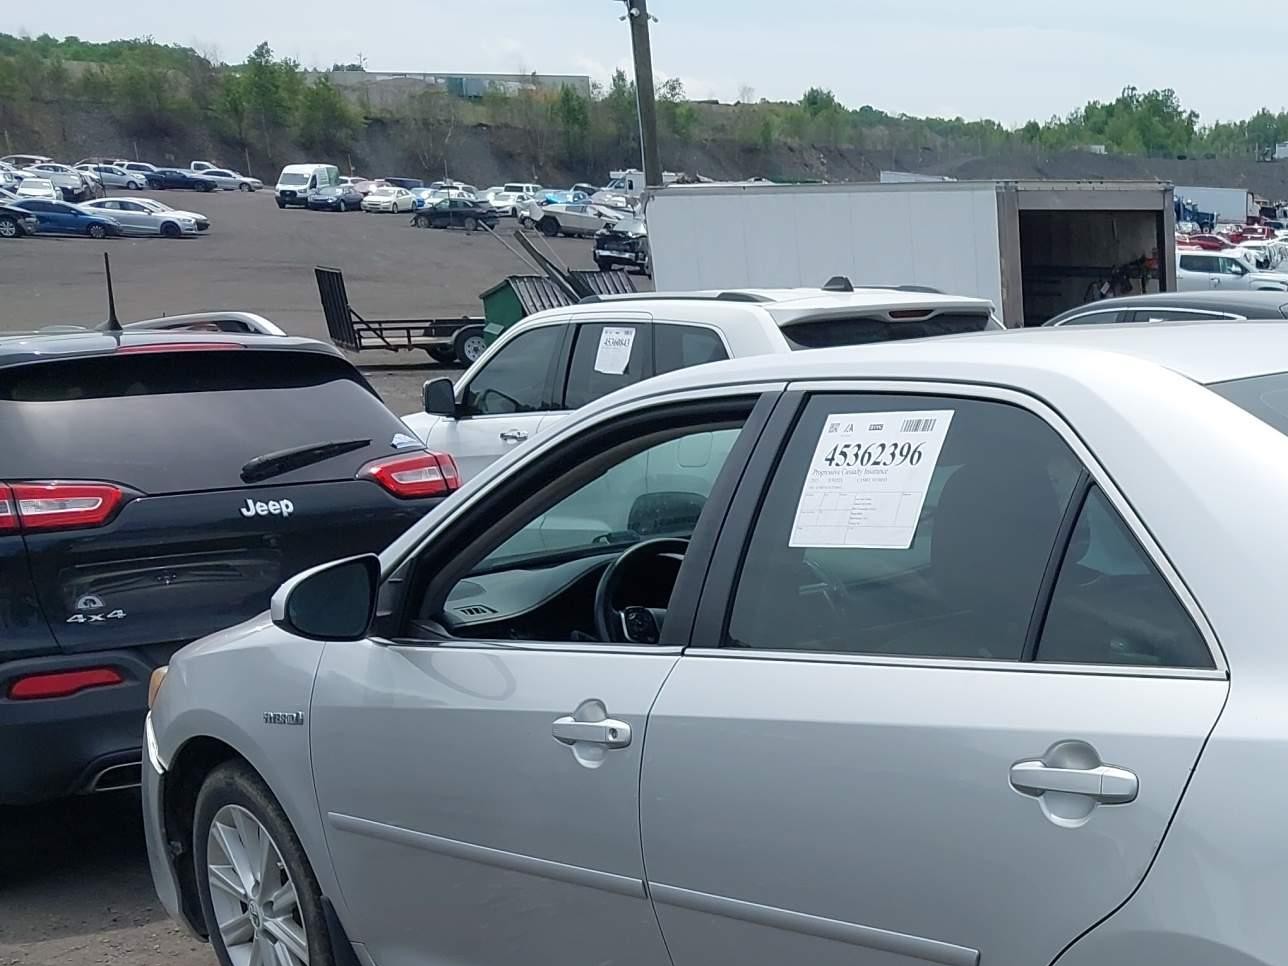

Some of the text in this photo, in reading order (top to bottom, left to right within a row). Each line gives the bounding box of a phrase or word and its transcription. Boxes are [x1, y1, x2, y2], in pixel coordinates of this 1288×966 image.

[825, 441, 927, 467] 45362396
[242, 498, 294, 517] Jeep
[66, 609, 127, 623] 4x4
